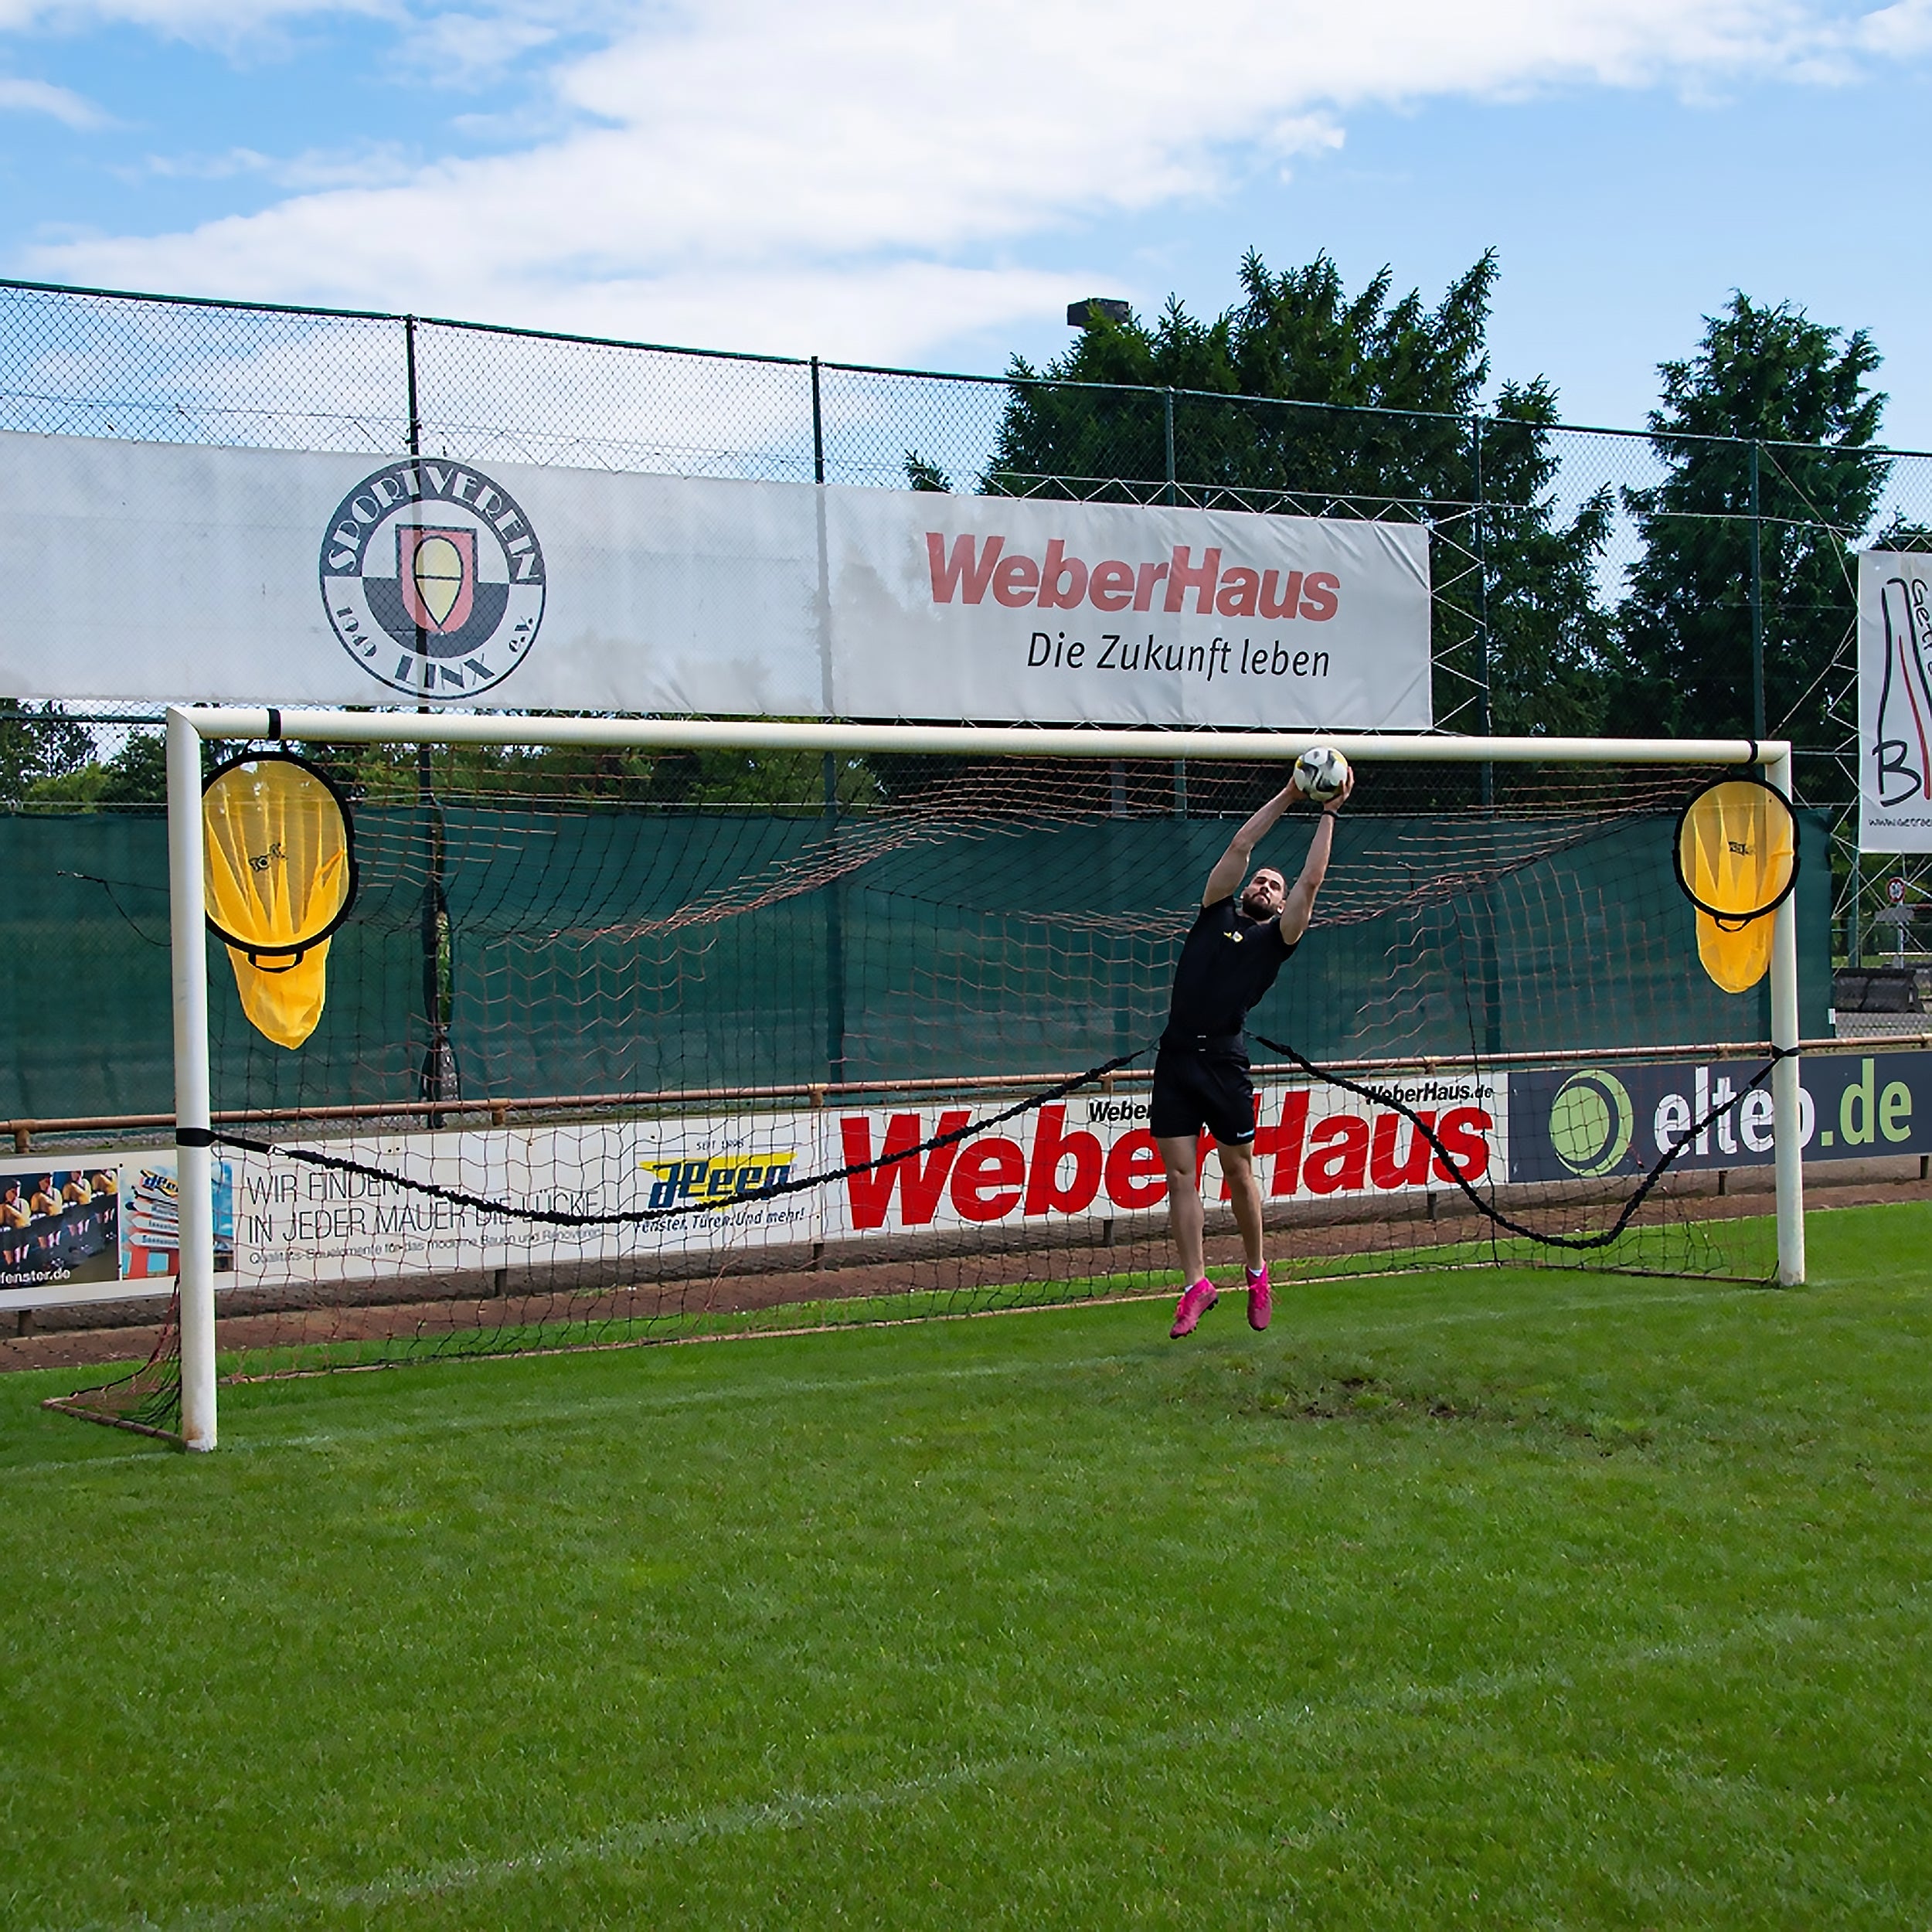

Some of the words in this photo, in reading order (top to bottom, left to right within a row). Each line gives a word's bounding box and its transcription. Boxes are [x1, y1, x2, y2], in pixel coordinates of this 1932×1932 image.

[328, 466, 540, 580] SPORTVEREIN
[925, 532, 1342, 622] WeberHaus
[336, 607, 377, 657] 1949
[395, 653, 496, 690] LINX
[1027, 631, 1085, 668] Die
[1096, 633, 1232, 682] Zukunft
[1240, 638, 1330, 677] leben
[247, 1174, 298, 1205] WIR
[308, 1168, 400, 1200] FINDEN
[840, 1089, 1493, 1230] WeberHaus
[249, 1214, 272, 1243] IN
[282, 1207, 367, 1242] JEDER
[376, 1201, 465, 1233] MAUER
[766, 1206, 805, 1223] mehr!
